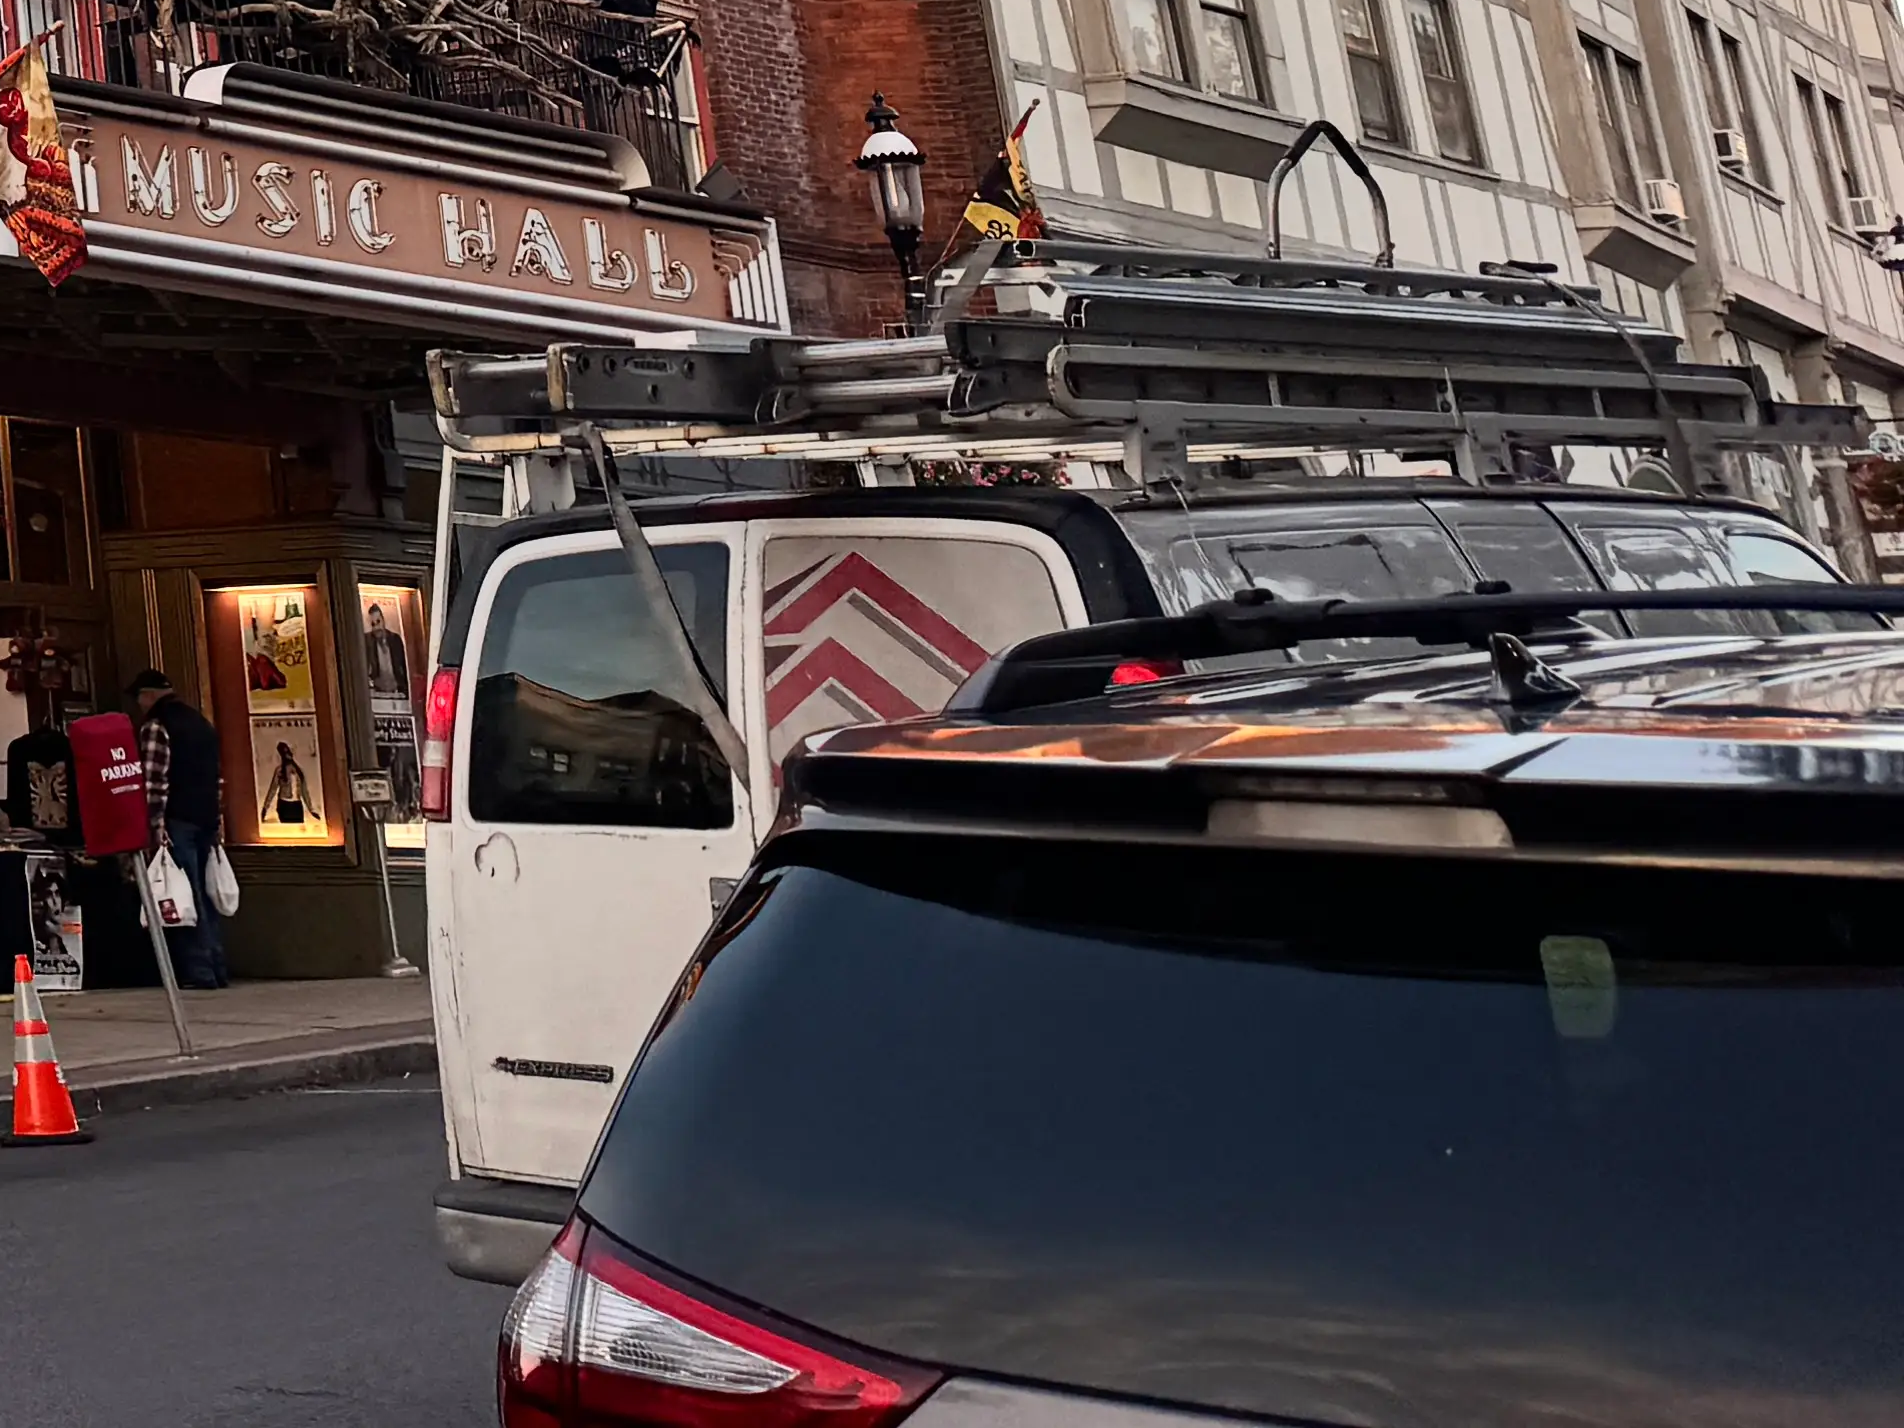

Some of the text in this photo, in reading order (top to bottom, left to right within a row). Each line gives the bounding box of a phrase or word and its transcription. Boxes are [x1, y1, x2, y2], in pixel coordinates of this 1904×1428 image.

[118, 132, 697, 302] MUSIC HALL
[110, 747, 126, 760] NO
